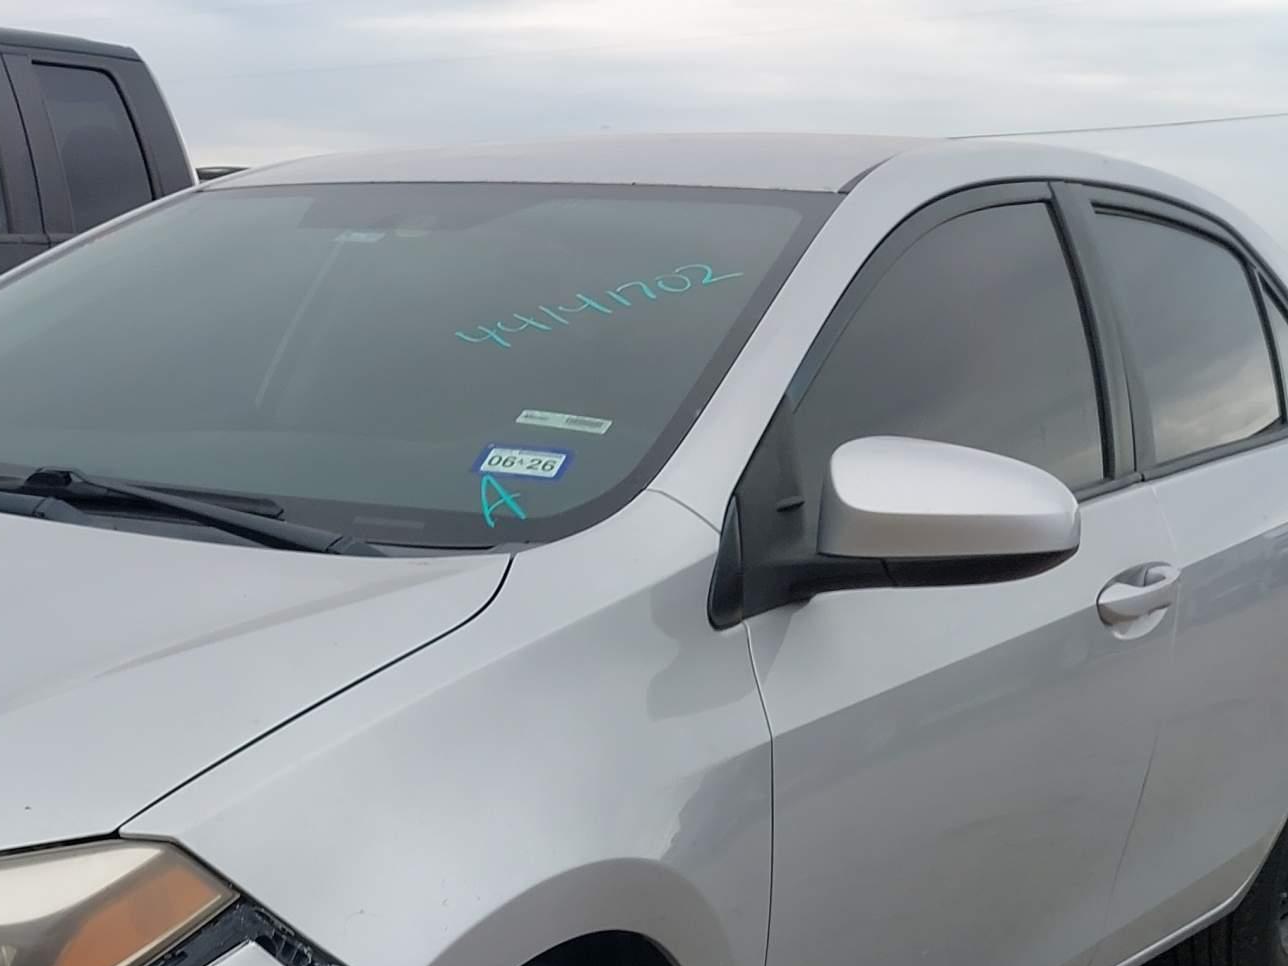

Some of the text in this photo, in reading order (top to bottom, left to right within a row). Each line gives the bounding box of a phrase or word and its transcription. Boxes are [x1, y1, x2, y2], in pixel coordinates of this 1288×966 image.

[455, 263, 744, 347] 44141702
[487, 455, 557, 472] 06 26
[481, 473, 526, 528] A
